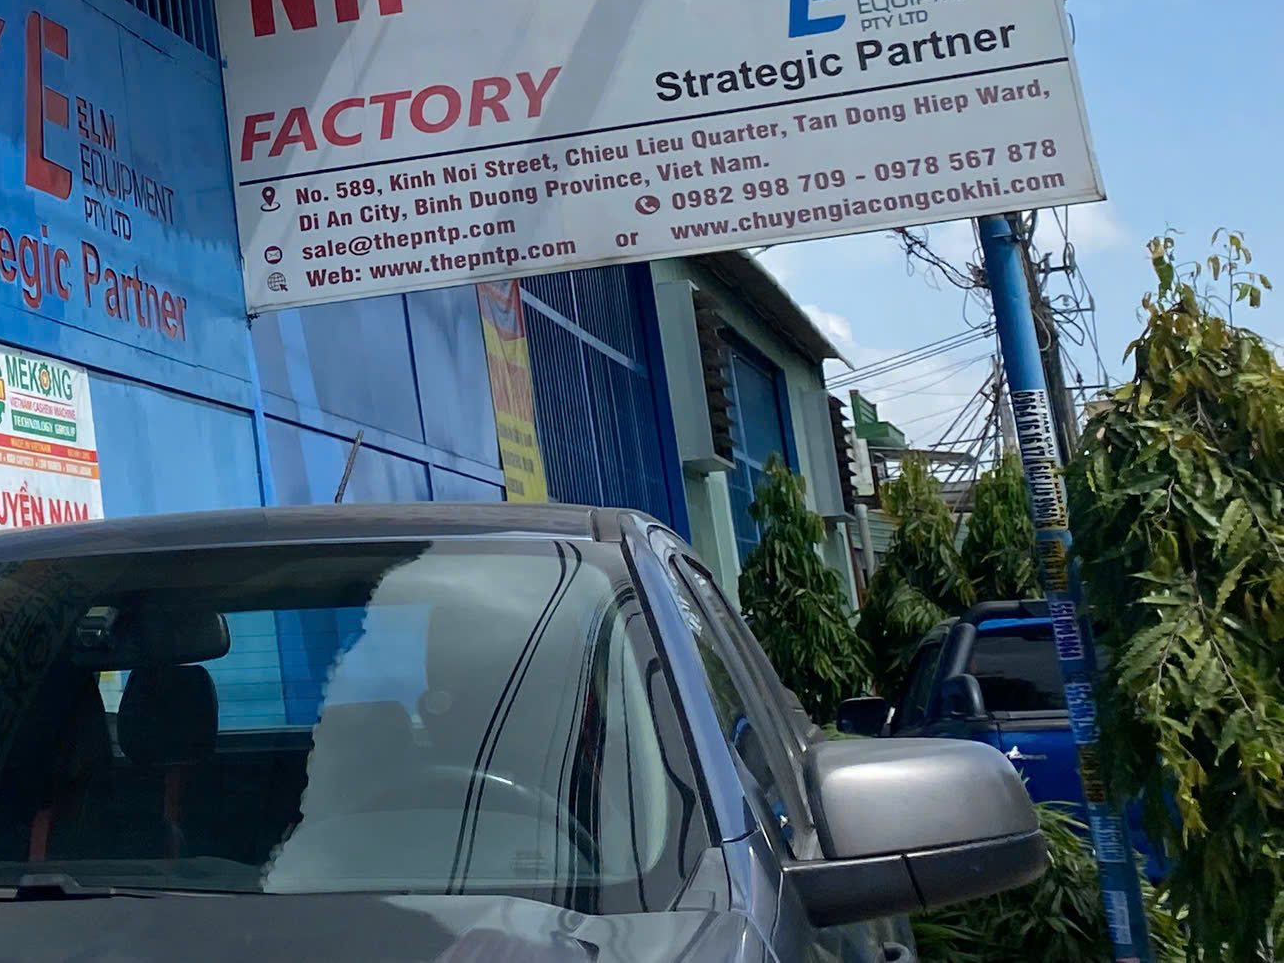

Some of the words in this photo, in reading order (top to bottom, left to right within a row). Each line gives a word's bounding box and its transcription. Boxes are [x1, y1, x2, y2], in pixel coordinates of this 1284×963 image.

[861, 15, 893, 32] PTY
[899, 10, 928, 27] LTD
[656, 49, 843, 102] Strategic
[856, 24, 1016, 71] Partner
[76, 96, 117, 153] ELM
[240, 66, 562, 162] FACTORY
[296, 186, 329, 205] No.
[336, 178, 383, 199] 589,
[390, 170, 435, 192] Kinh
[443, 163, 477, 184] Noi
[485, 153, 558, 179] Street,
[565, 143, 628, 167] Chieu
[637, 135, 684, 156] Lieu
[691, 119, 787, 148] Quarter,
[793, 111, 837, 134] Tan
[845, 101, 906, 129] Dong
[914, 92, 969, 118] Hiep
[976, 78, 1050, 105] Ward,
[80, 143, 173, 225] EQUIPMENT
[299, 213, 320, 232] Di
[327, 209, 353, 229] An
[359, 200, 408, 225] City,
[416, 193, 462, 217] Binh
[470, 183, 537, 210] Duong
[545, 170, 650, 198] Province,
[658, 158, 704, 183] Viet
[711, 151, 770, 175] Nam.
[616, 231, 639, 249] or
[671, 171, 1066, 241] www.chuyengiacongcokhi.com
[672, 187, 734, 211] 0982
[743, 177, 789, 201] 998
[797, 168, 846, 193] 709
[875, 154, 940, 182] 0978
[949, 146, 997, 172] 567
[1008, 138, 1057, 163] 878
[84, 195, 107, 231] PTY
[110, 207, 132, 240] LTD
[302, 217, 515, 261] sale@thepntp.com
[81, 240, 187, 342] Partner
[306, 267, 362, 288] Web:
[369, 238, 577, 280] www.thepntp.com
[5, 355, 73, 401] MEKONG
